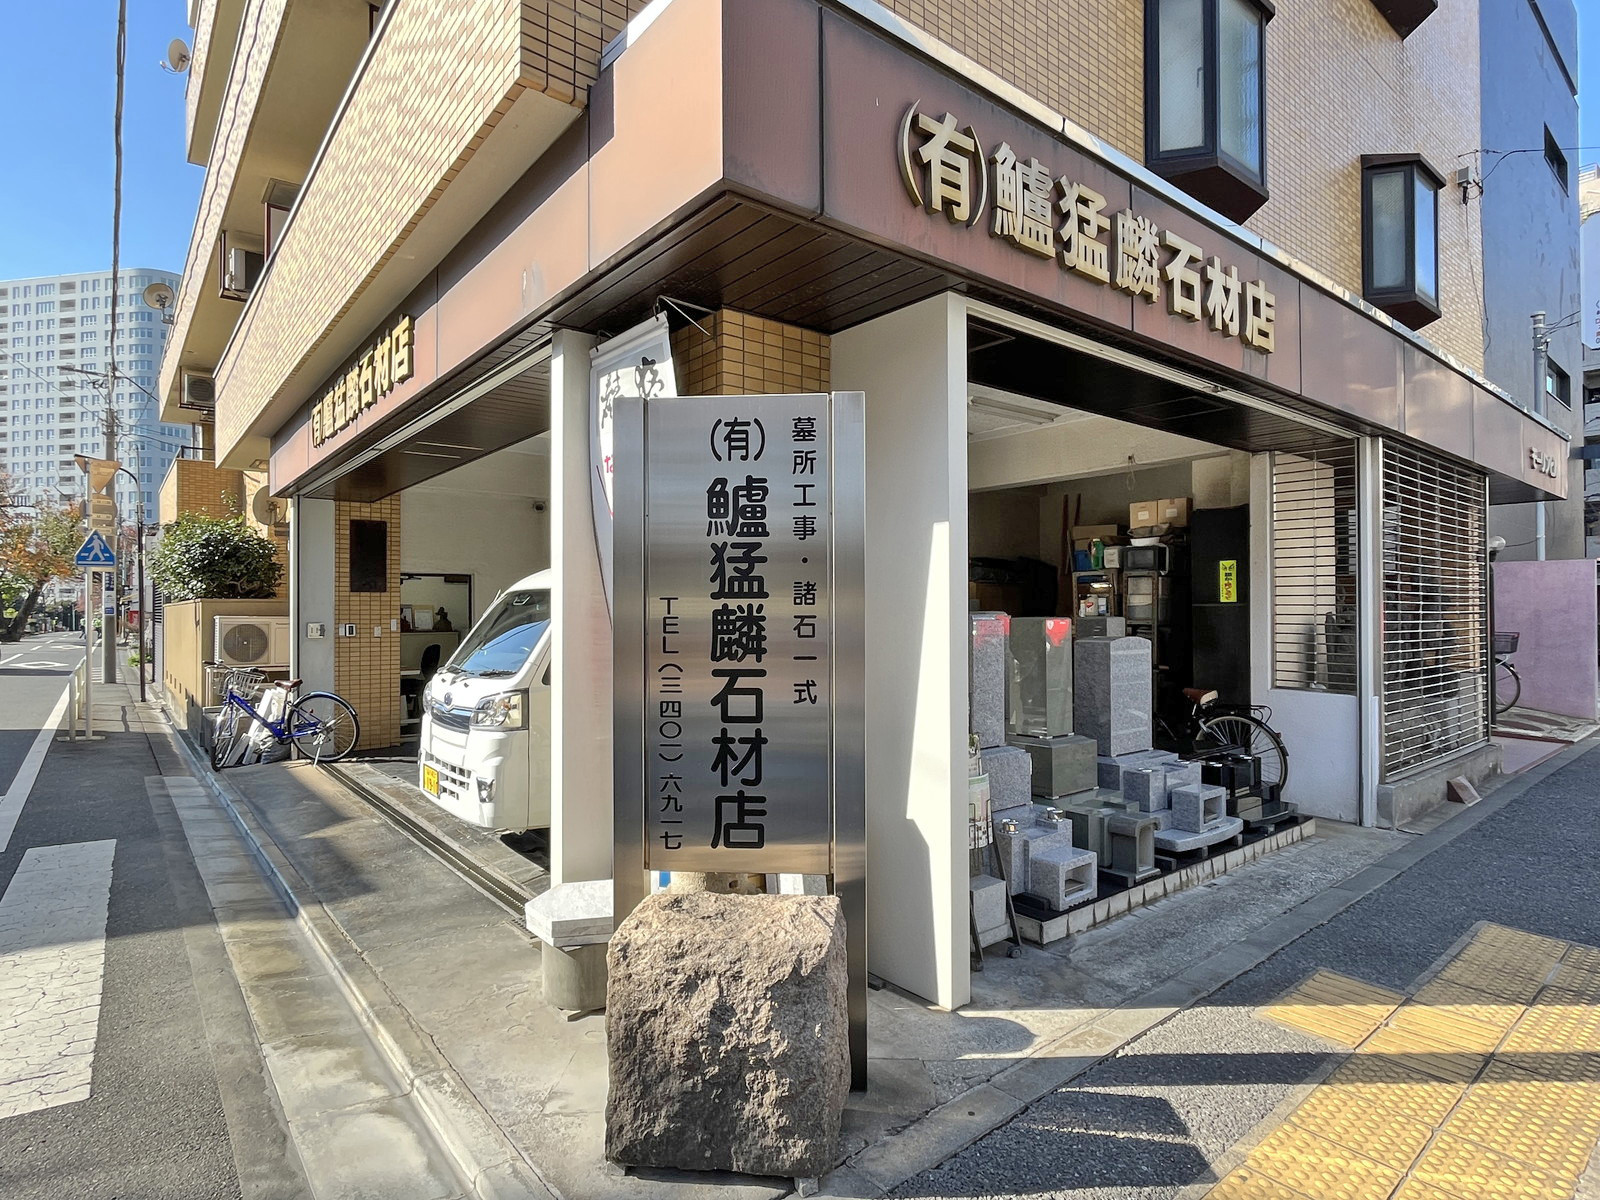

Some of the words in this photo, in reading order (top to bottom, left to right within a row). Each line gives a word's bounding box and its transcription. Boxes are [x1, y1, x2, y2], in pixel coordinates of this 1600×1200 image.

[791, 416, 817, 705] 墓所工事・諸石一式
